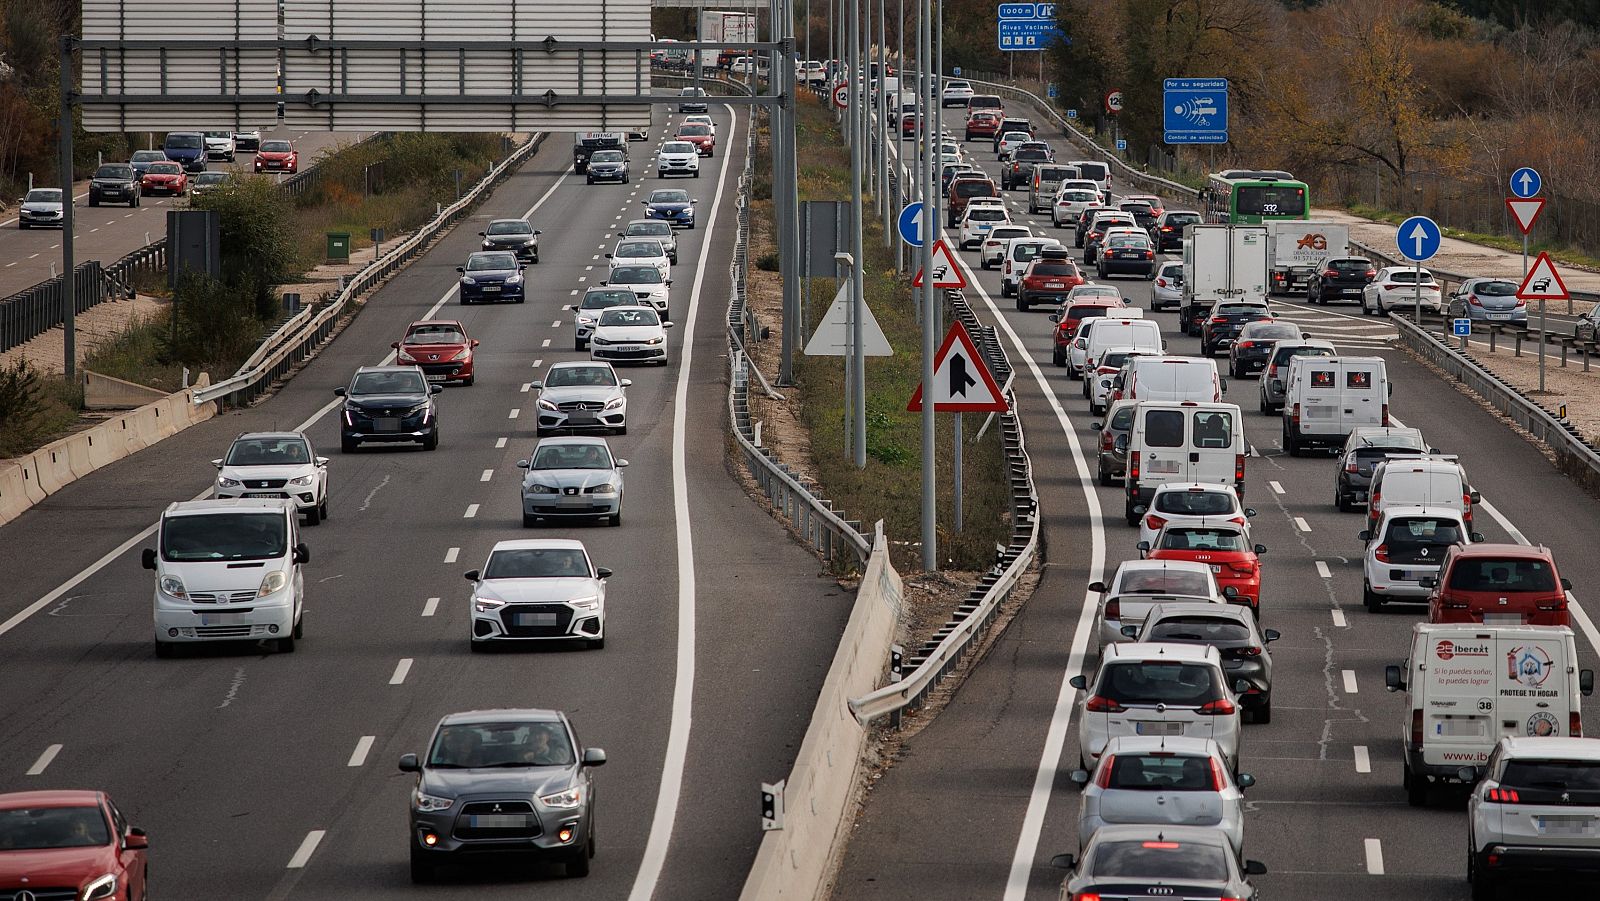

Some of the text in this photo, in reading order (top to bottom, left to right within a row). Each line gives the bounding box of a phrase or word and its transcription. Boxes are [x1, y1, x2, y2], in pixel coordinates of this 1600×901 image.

[1263, 204, 1278, 212] 332
[1296, 233, 1327, 250] AG
[1454, 644, 1489, 653] Iberext
[1448, 668, 1472, 676] puedes
[1445, 678, 1469, 686] puedes
[1470, 678, 1490, 686] lograr
[1500, 689, 1527, 697] PROTEGE
[1479, 701, 1492, 710] 38
